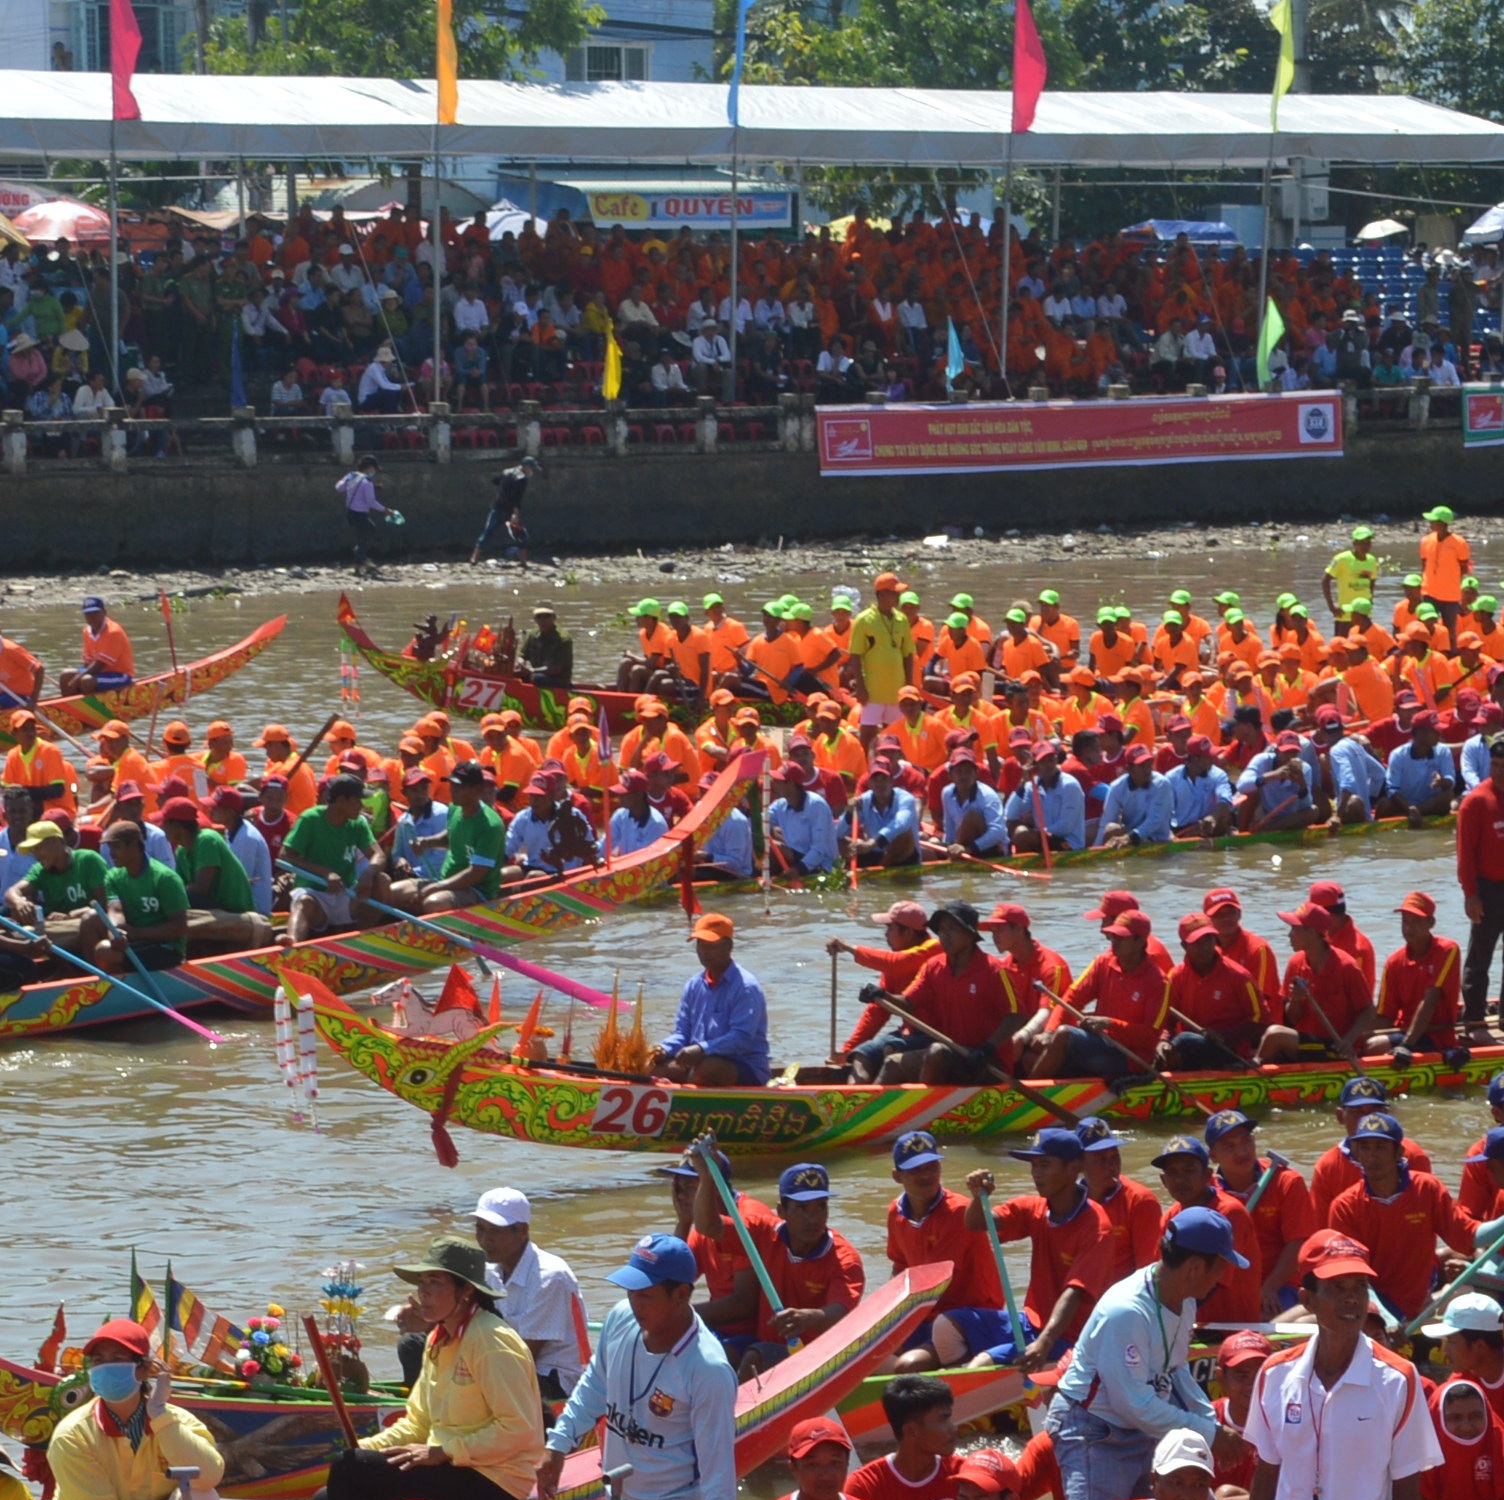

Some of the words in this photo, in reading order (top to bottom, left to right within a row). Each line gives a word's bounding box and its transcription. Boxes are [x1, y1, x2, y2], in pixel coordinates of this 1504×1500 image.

[461, 681, 503, 709] 27
[141, 896, 159, 913] 39
[591, 1087, 669, 1135] 26
